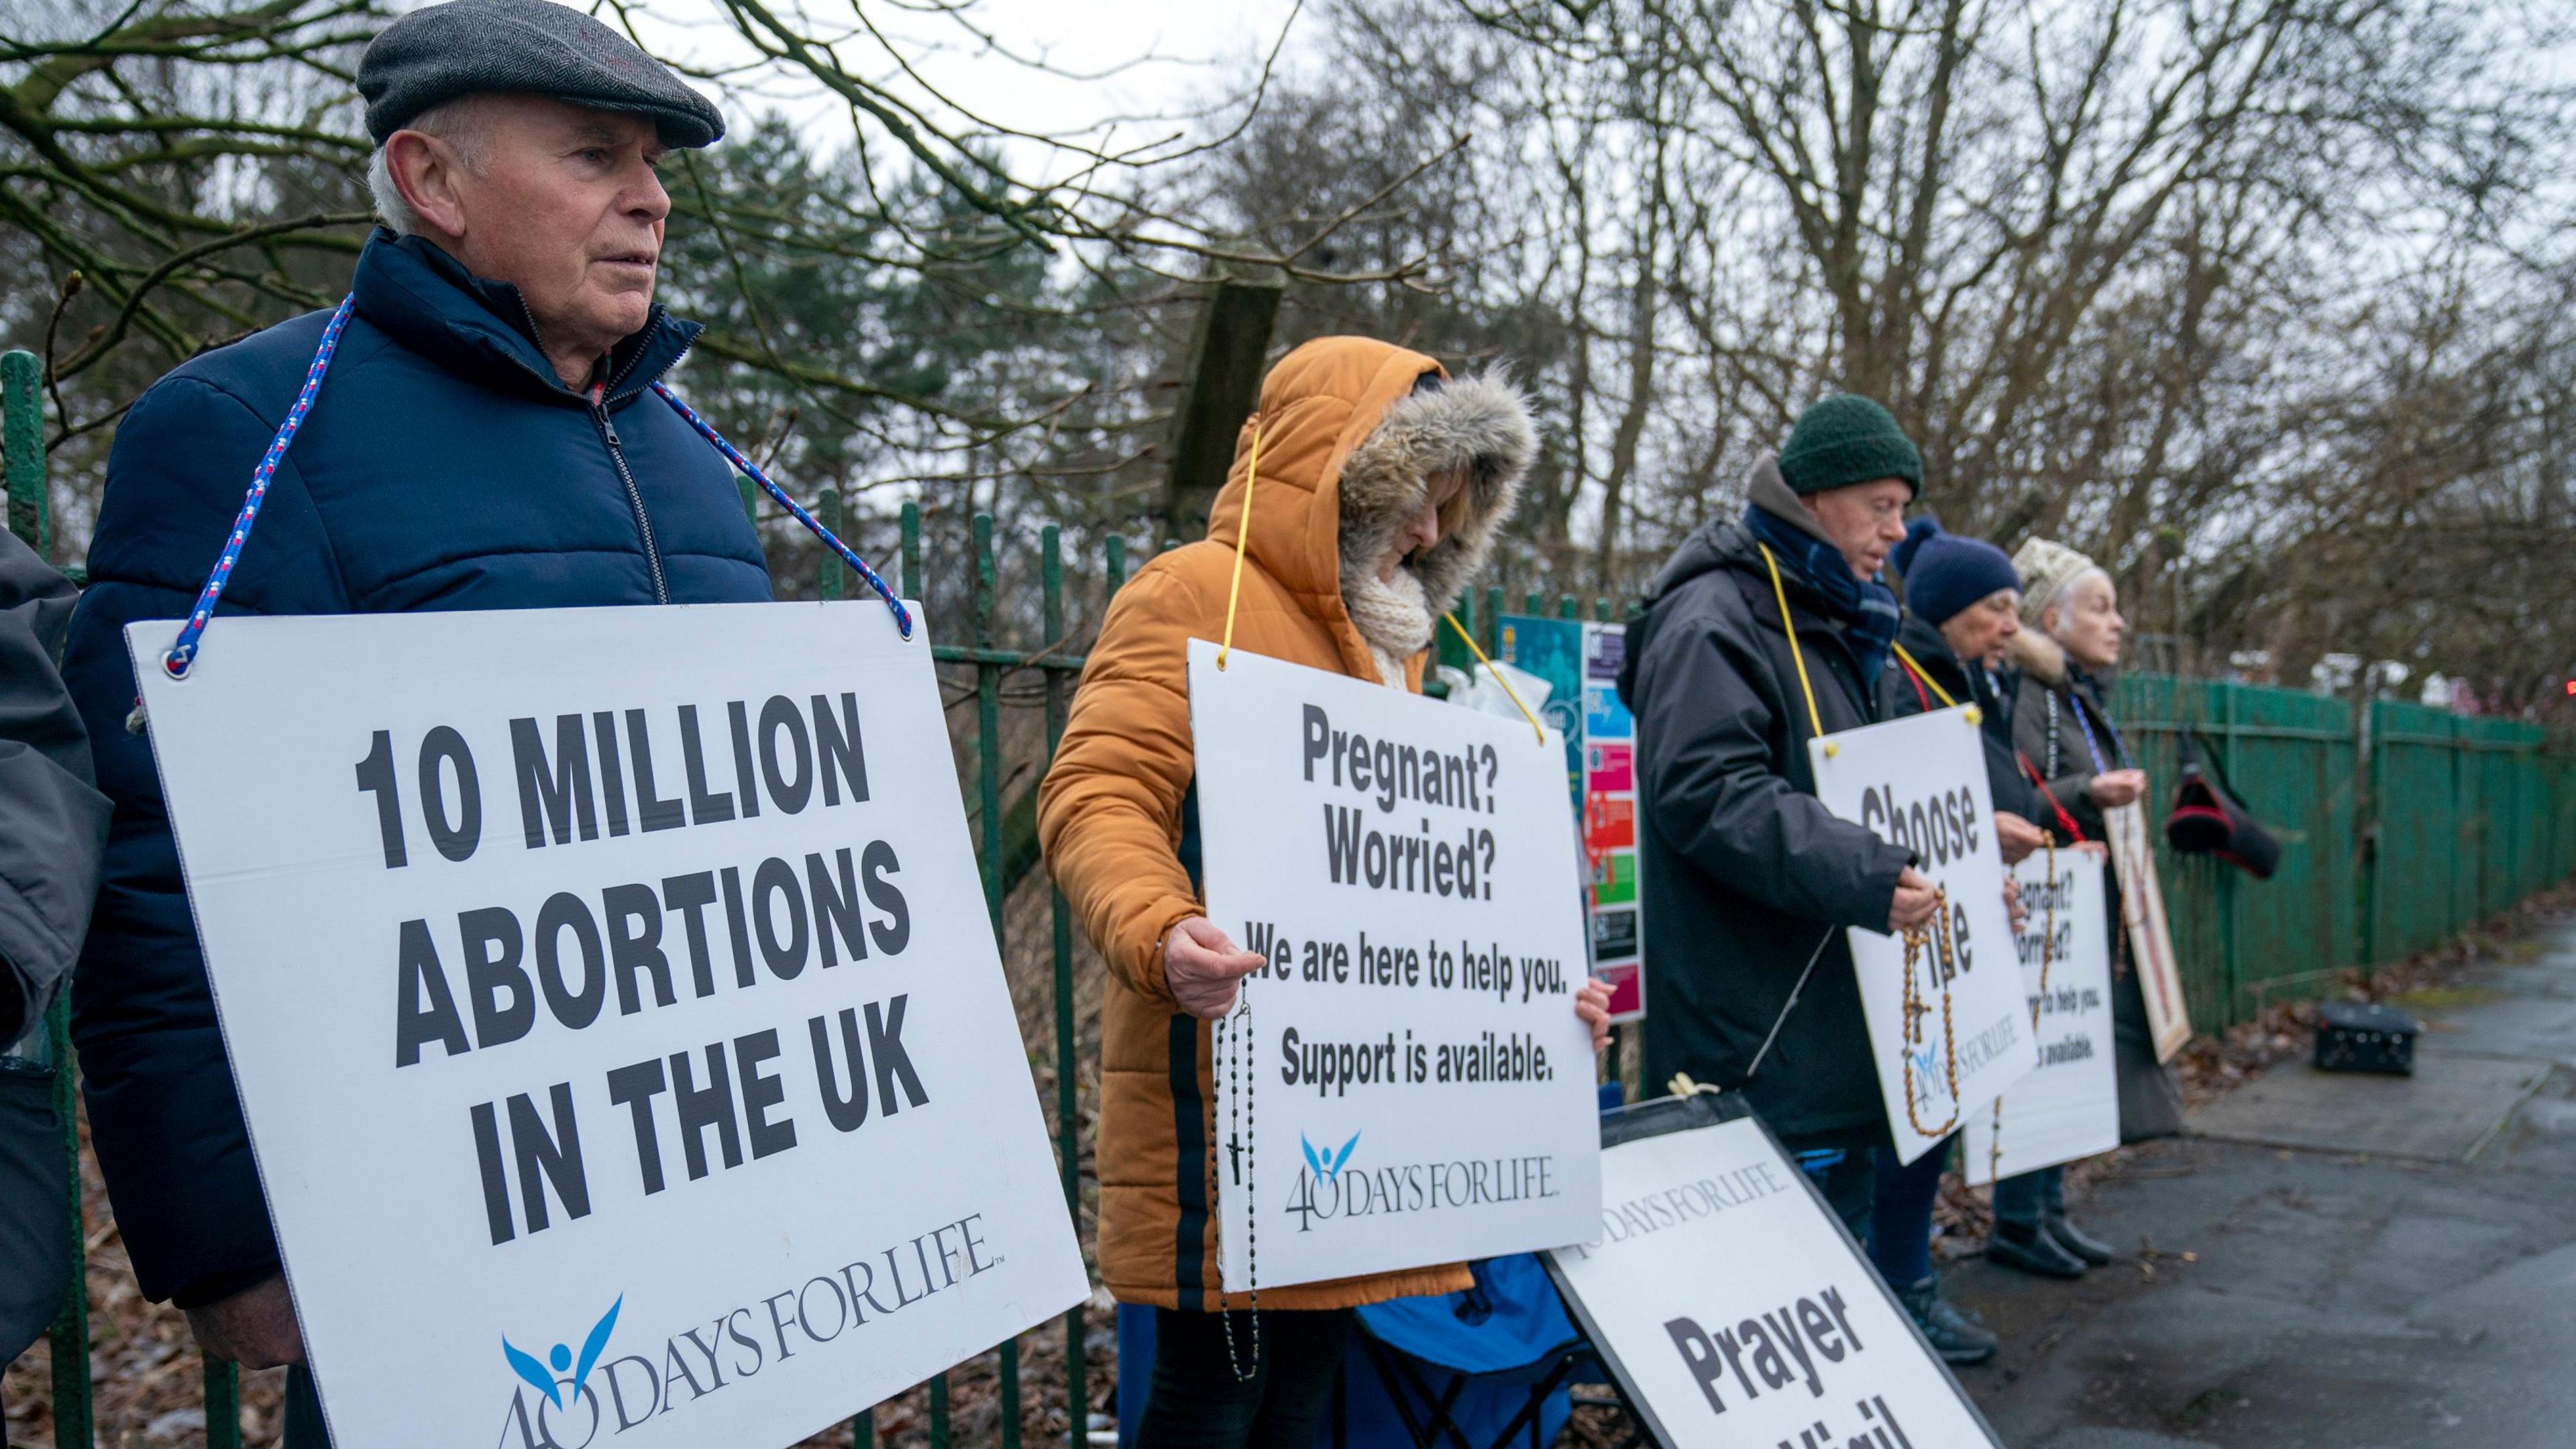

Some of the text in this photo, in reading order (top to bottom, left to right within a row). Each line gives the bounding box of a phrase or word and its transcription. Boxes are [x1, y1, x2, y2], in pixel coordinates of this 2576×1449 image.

[355, 692, 870, 869] 10 MILLION
[1303, 703, 1498, 813] Pregnant?
[1325, 804, 1495, 901] Worried?
[396, 839, 910, 1069] ABORTIONS
[1245, 921, 1291, 981] We
[1303, 940, 1348, 982] are
[1360, 931, 1419, 987] here
[1430, 940, 1453, 989] to
[1462, 940, 1512, 1002] help
[1521, 957, 1567, 1000] you.
[470, 994, 930, 1246] IN THE UK
[1281, 1026, 1552, 1097] Support is available.
[1663, 1284, 1864, 1415] Prayer
